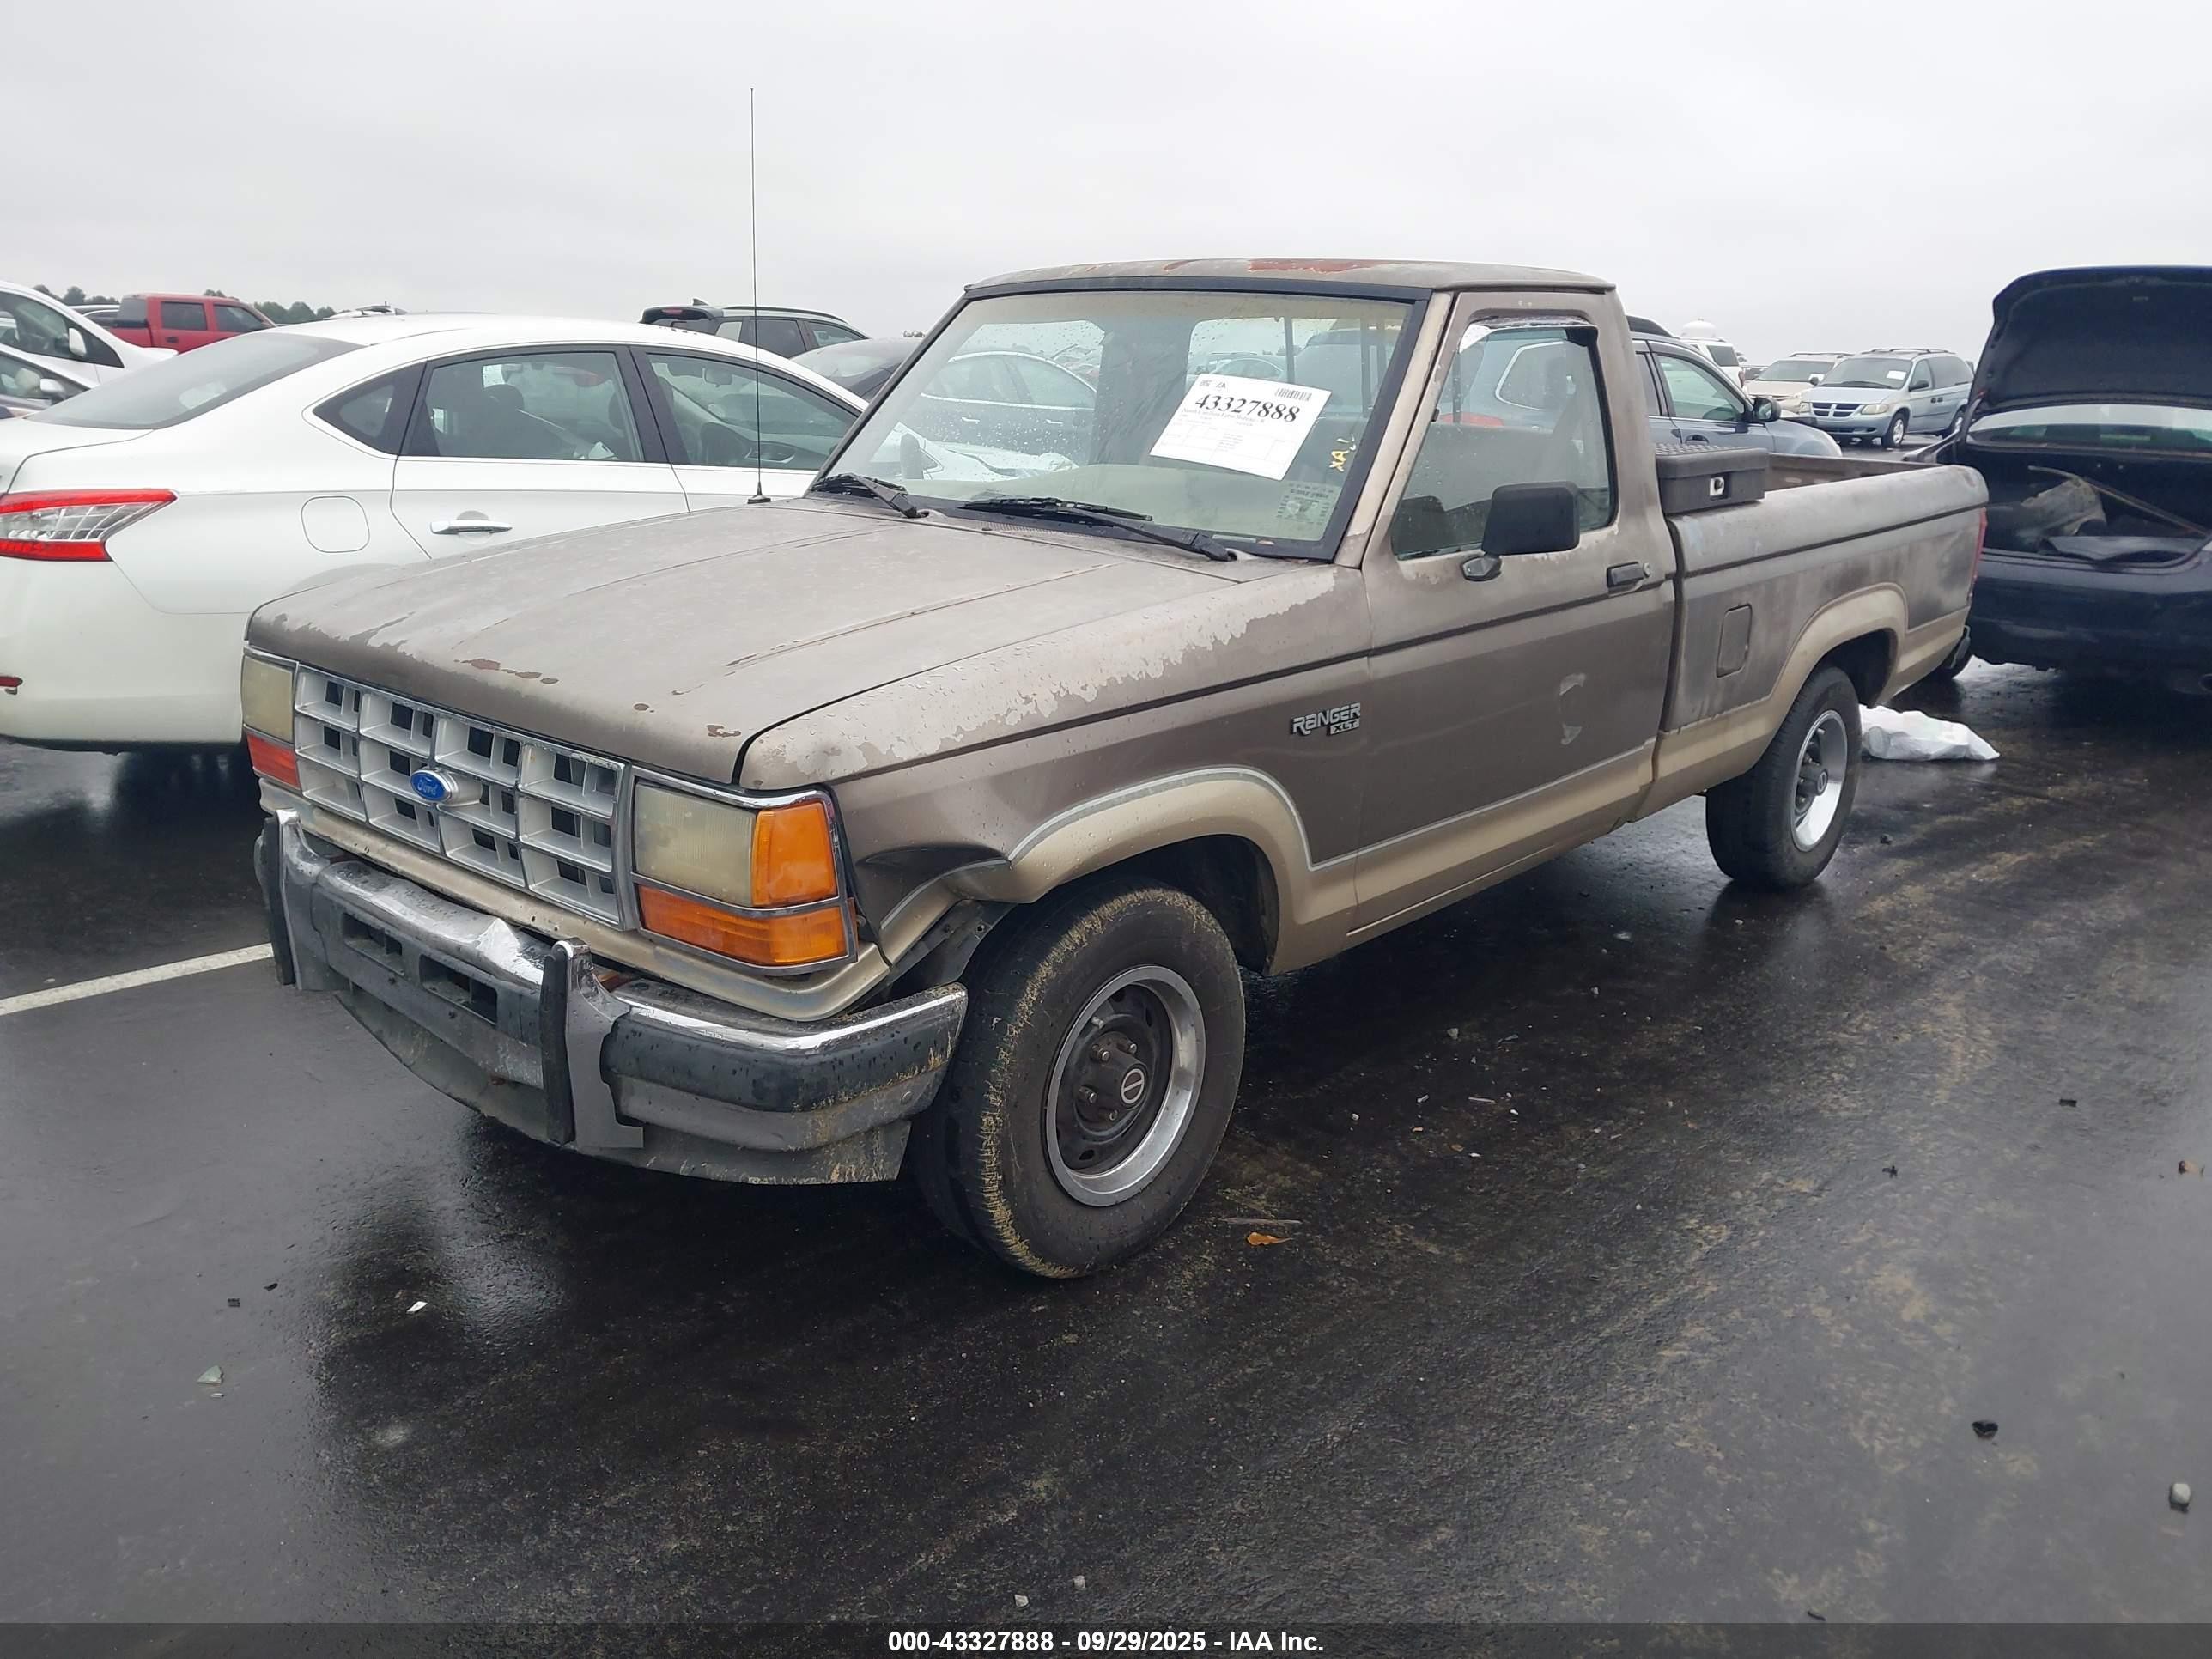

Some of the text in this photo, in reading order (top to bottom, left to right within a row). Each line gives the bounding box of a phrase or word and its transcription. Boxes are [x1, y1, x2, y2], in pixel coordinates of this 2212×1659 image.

[1194, 393, 1301, 422] 43327888
[1291, 702, 1361, 736] RANGER
[1333, 720, 1358, 734] XLT
